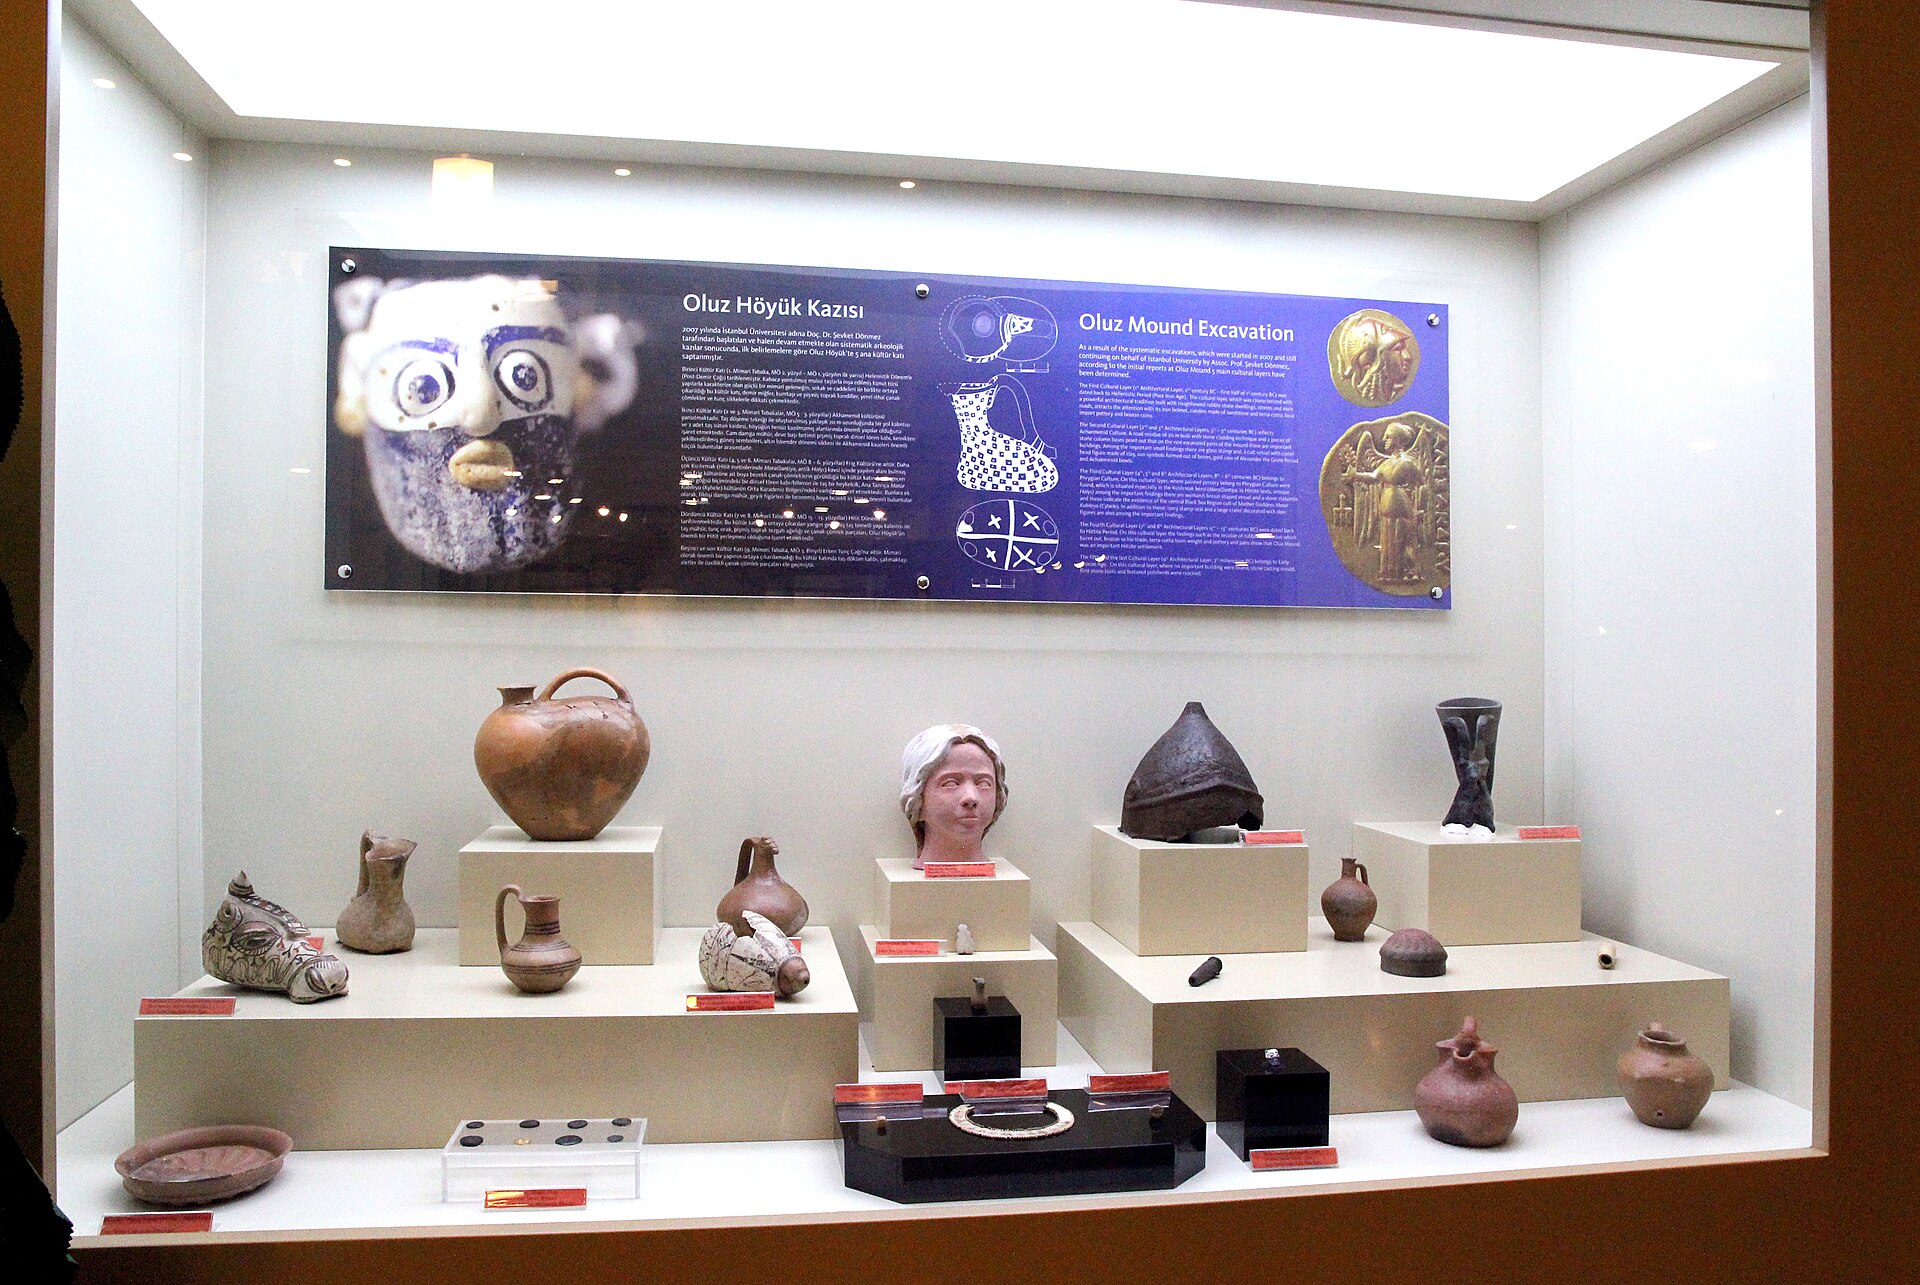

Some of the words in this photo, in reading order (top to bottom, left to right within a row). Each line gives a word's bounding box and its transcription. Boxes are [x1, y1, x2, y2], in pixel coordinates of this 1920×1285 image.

[683, 294, 730, 313] Oluz
[736, 296, 801, 320] Höyük
[808, 299, 864, 318] Kazısı
[700, 326, 720, 335] yılında
[722, 326, 748, 334] İstanbul
[750, 327, 786, 336] Üniversitesi
[807, 330, 821, 339] Doç.
[833, 331, 853, 340] Şevket
[1079, 313, 1123, 332] Oluz
[1128, 316, 1192, 336] Mound
[1198, 320, 1294, 342] Excavation
[704, 344, 740, 354] sonucunda,
[794, 348, 807, 356] göre
[717, 336, 746, 345] başlatılan
[874, 342, 904, 351] arkeolojik
[682, 353, 723, 362] saptanmıştır.
[1130, 346, 1160, 355] systematic
[1162, 348, 1197, 357] excavations,
[1079, 352, 1110, 361] continuing
[1173, 357, 1201, 366] University
[1079, 360, 1108, 370] according
[1146, 364, 1167, 373] reports
[1254, 370, 1270, 378] layers
